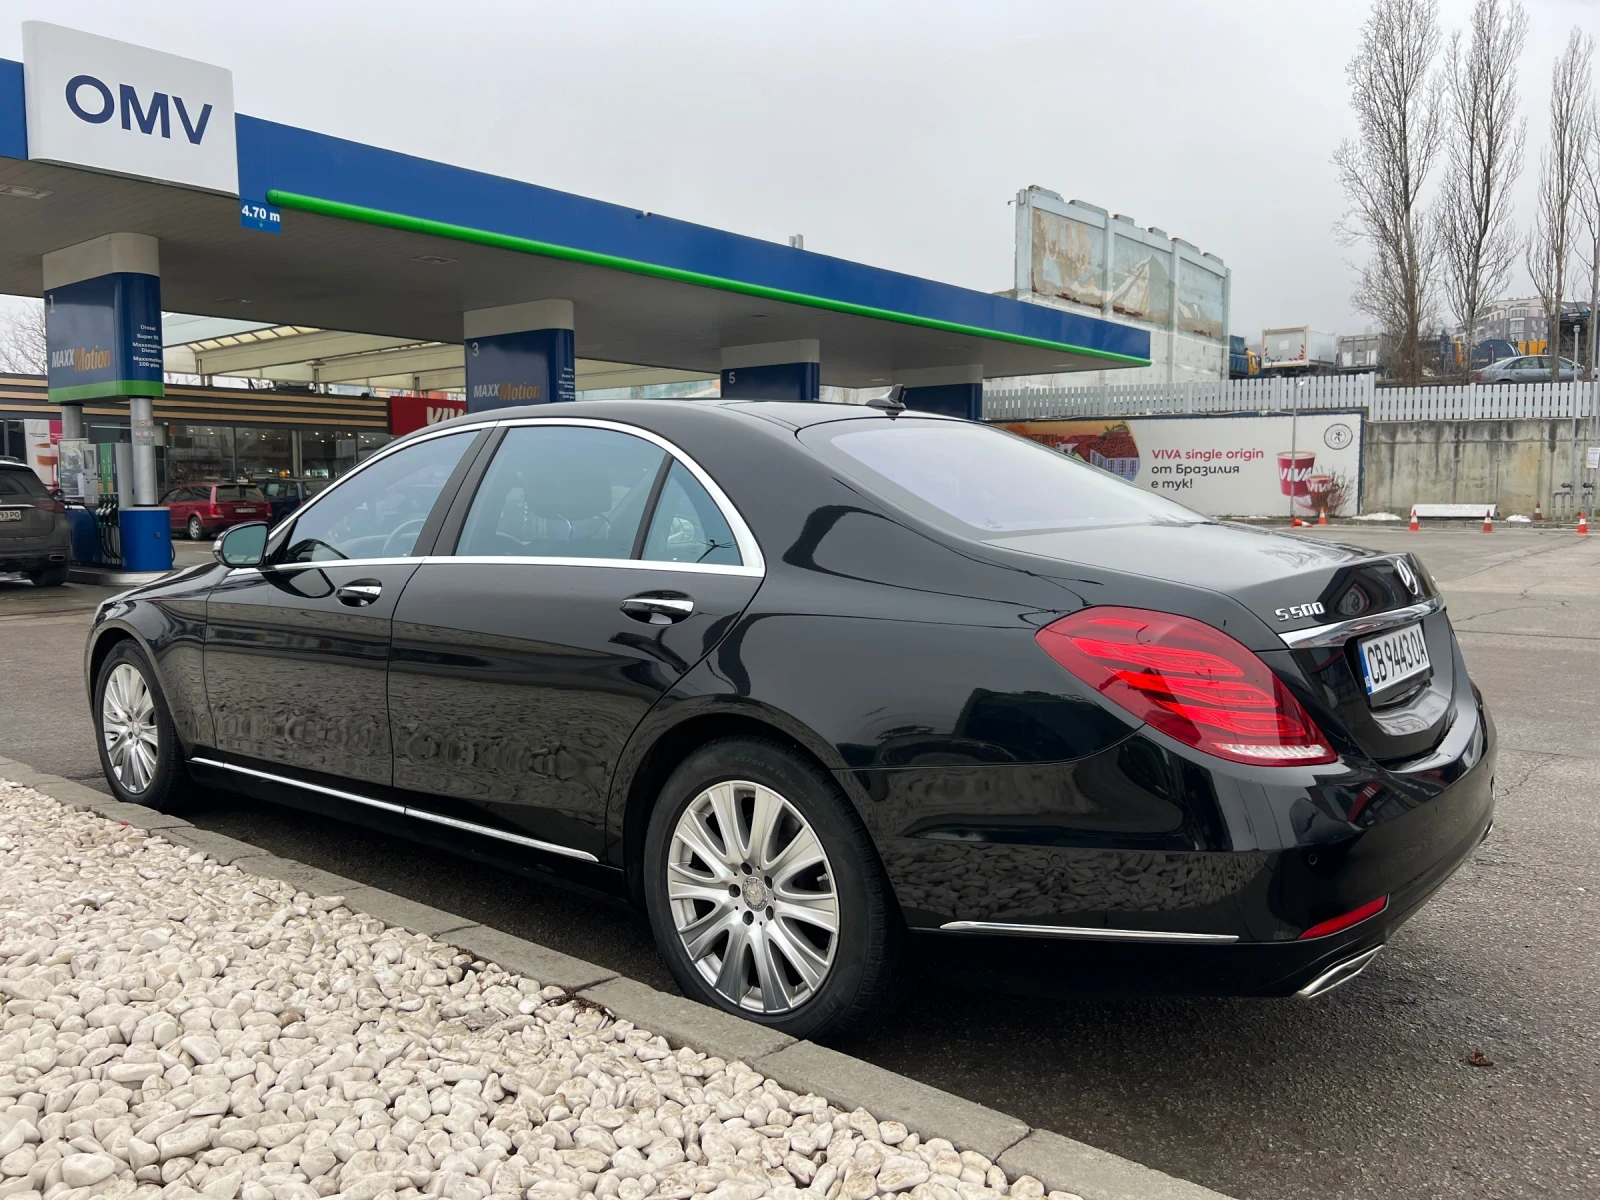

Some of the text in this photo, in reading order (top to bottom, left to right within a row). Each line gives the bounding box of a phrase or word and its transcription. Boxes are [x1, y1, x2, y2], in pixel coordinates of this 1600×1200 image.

[65, 74, 213, 146] OMV
[241, 204, 281, 223] 4.70 m
[49, 294, 56, 314] 1
[471, 342, 479, 357] 3
[728, 371, 736, 384] 5
[1151, 448, 1264, 462] VIVA single origin
[1151, 463, 1240, 476] от Бразилия
[1150, 478, 1193, 491] е тук!
[1275, 601, 1326, 622] S 500
